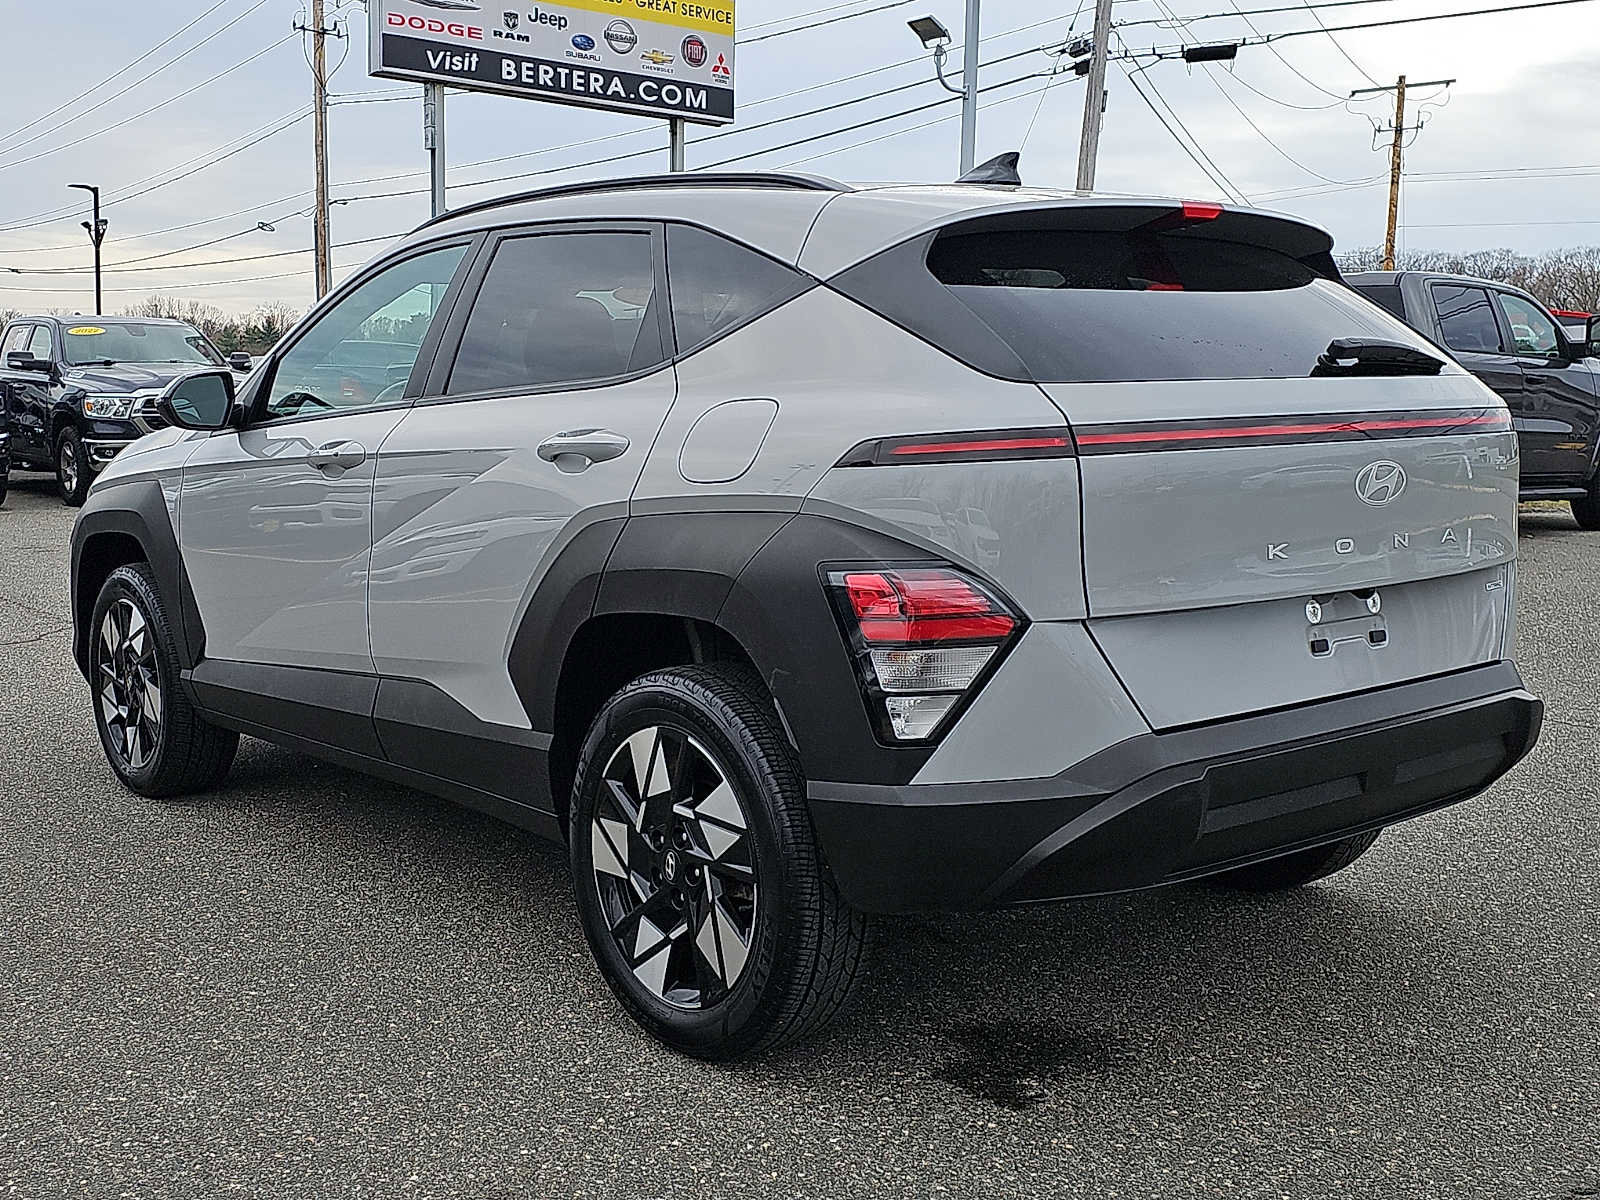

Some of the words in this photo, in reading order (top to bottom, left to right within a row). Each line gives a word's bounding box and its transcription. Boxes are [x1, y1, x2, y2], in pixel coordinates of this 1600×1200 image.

[527, 7, 568, 31] Jeep
[635, 0, 678, 14] GREAT
[681, 4, 732, 24] SERVICE
[387, 13, 483, 40] DODGE
[493, 30, 530, 43] RAM
[606, 30, 636, 44] NISSAN
[565, 50, 601, 62] SUBARU
[687, 44, 703, 60] FIAT
[426, 50, 480, 72] Visit
[501, 58, 707, 110] BERTERA.COM
